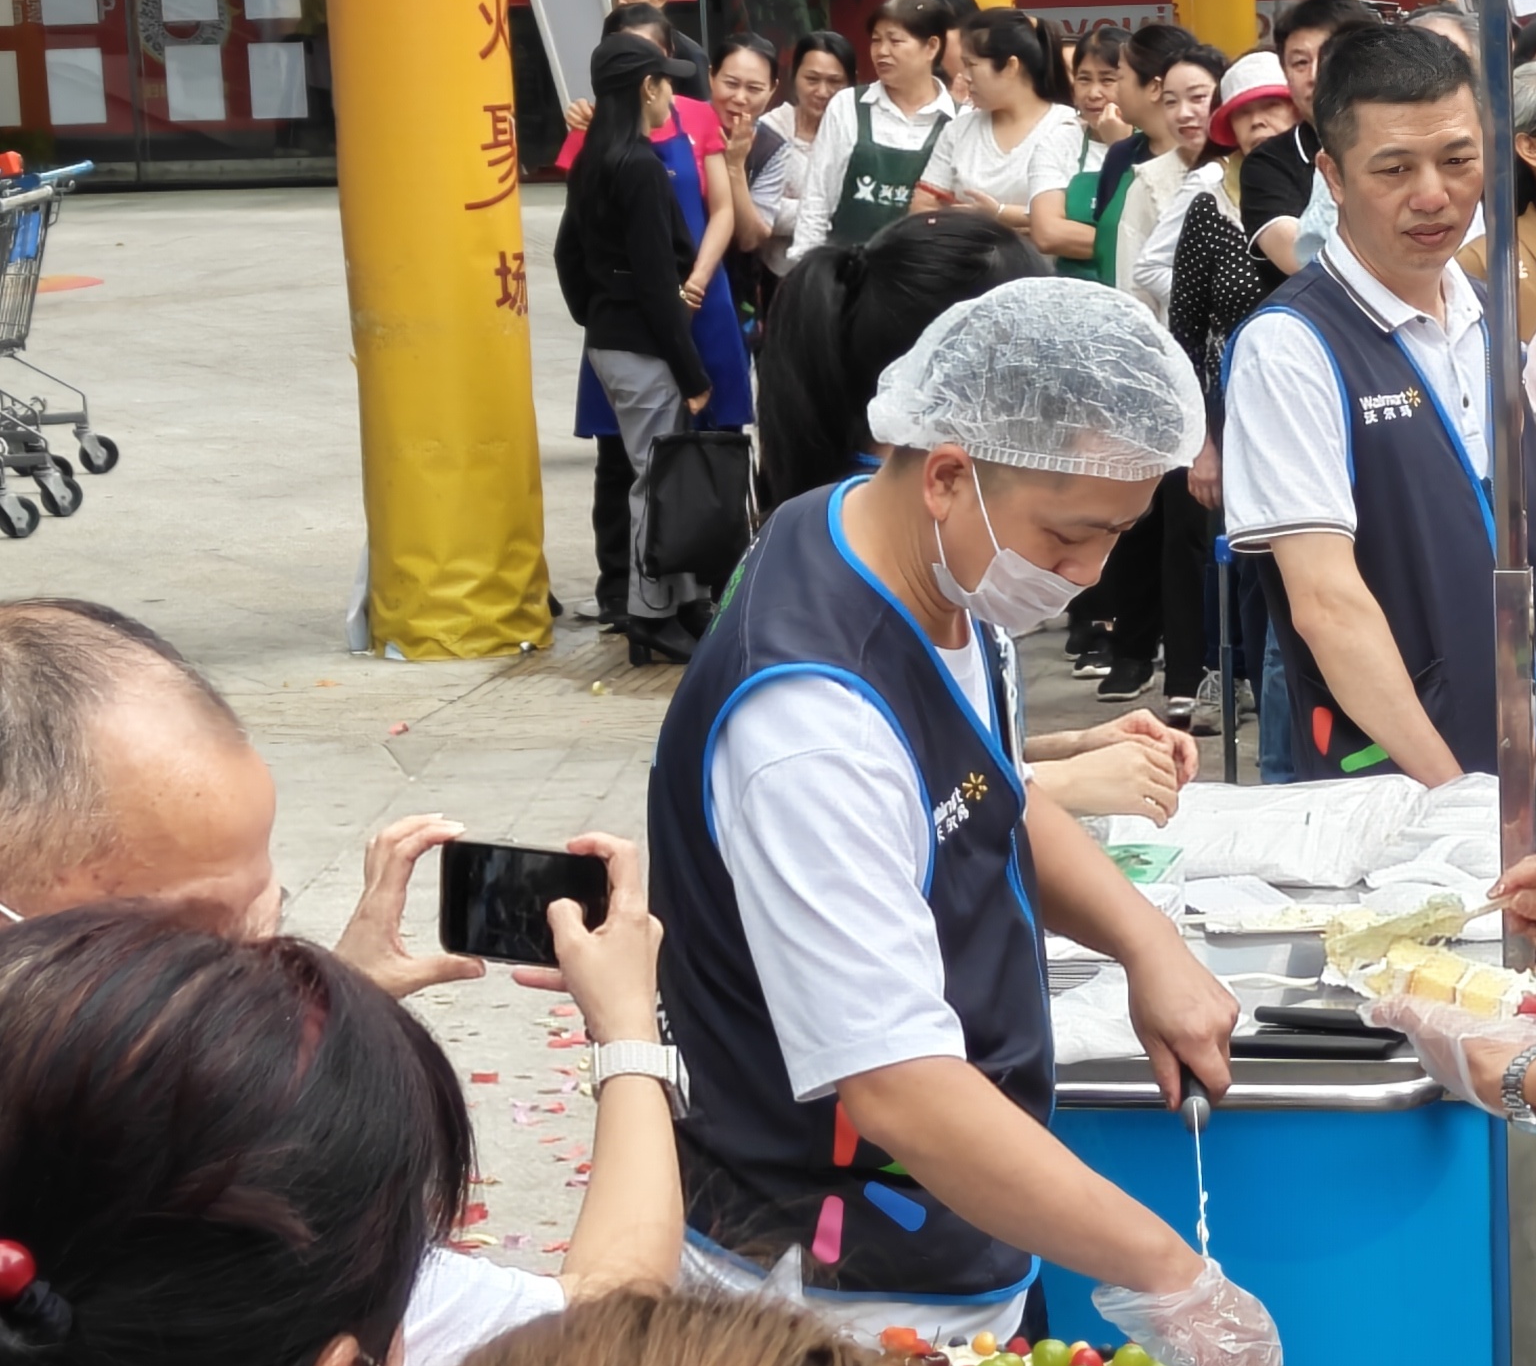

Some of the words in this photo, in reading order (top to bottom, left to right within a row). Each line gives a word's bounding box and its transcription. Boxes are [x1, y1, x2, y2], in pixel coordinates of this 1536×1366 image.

[1359, 391, 1409, 411] Walmart
[1363, 404, 1413, 425] 沃尔玛
